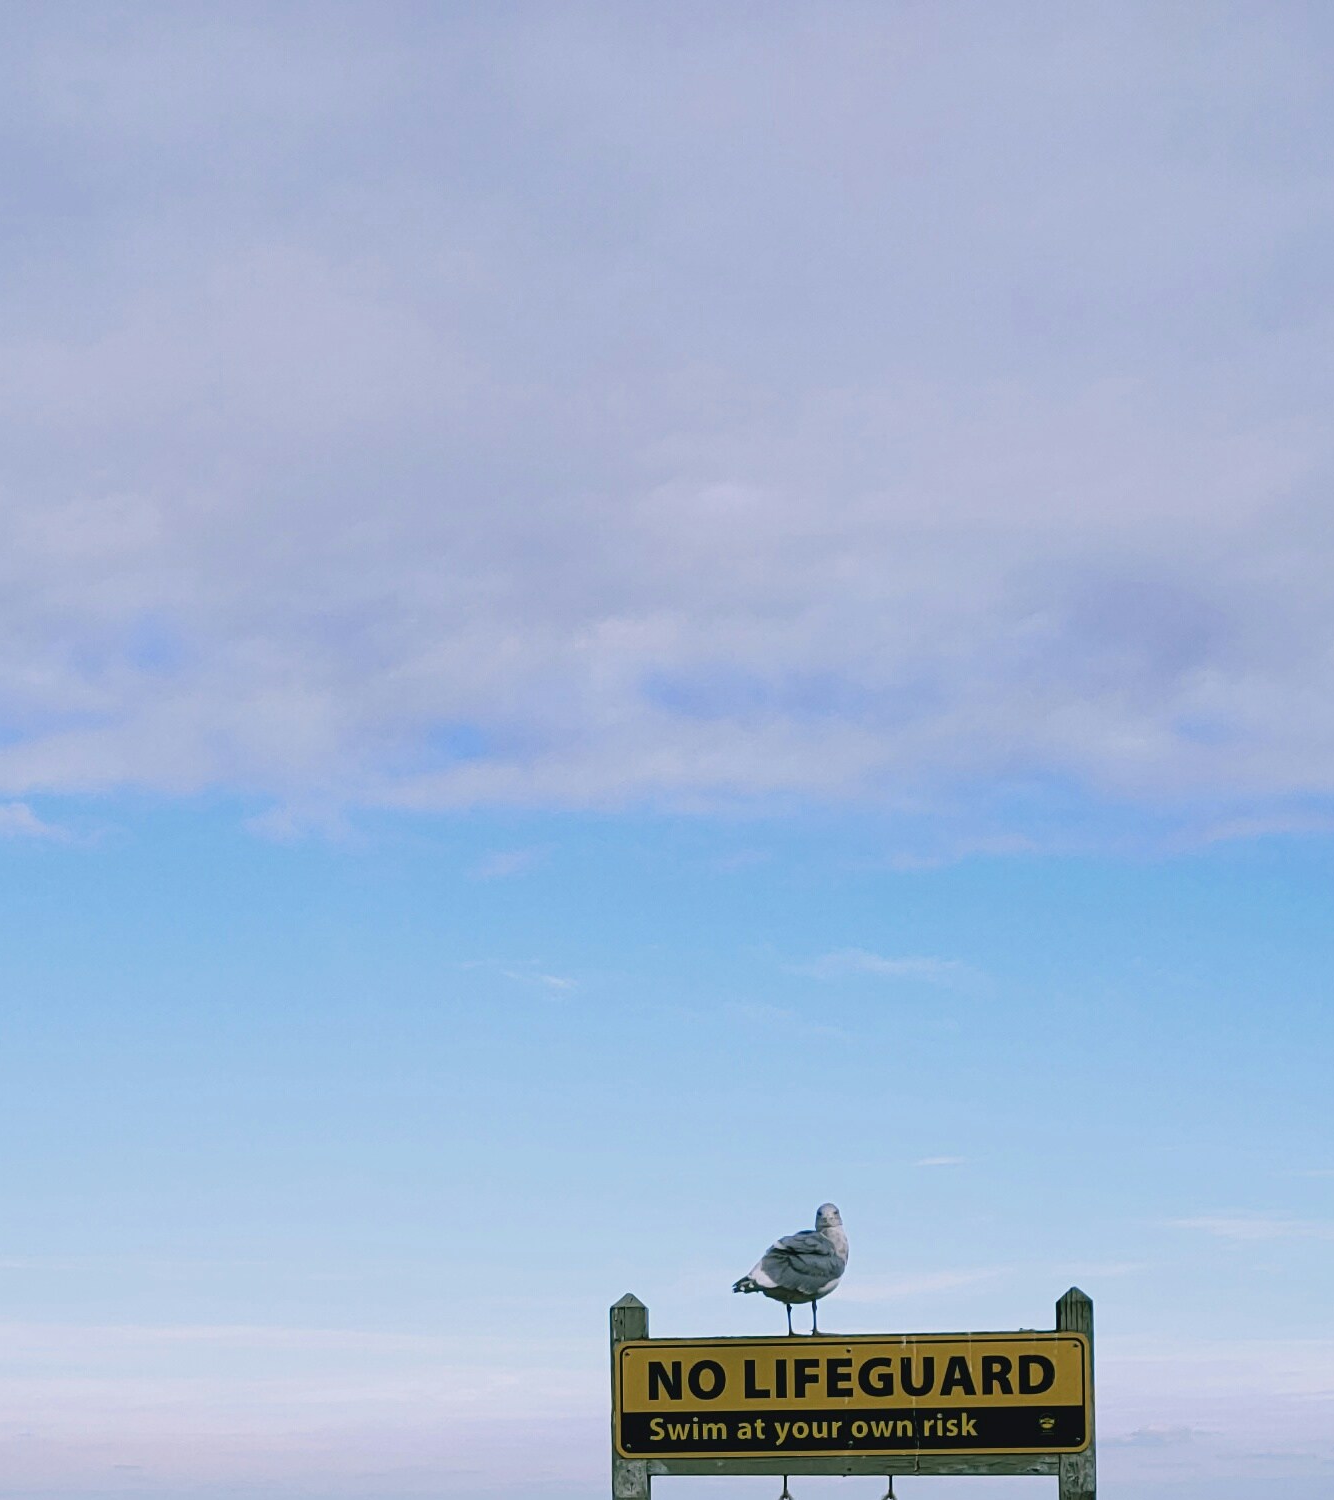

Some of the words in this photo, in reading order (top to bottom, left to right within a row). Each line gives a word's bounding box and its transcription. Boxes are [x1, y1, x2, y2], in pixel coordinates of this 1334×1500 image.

[648, 1359, 726, 1401] NO
[744, 1354, 1056, 1399] LIFEGUARD
[649, 1417, 727, 1440] Swim
[737, 1419, 766, 1440] at
[774, 1421, 842, 1446] your
[851, 1419, 913, 1438] own
[923, 1412, 978, 1437] risk
